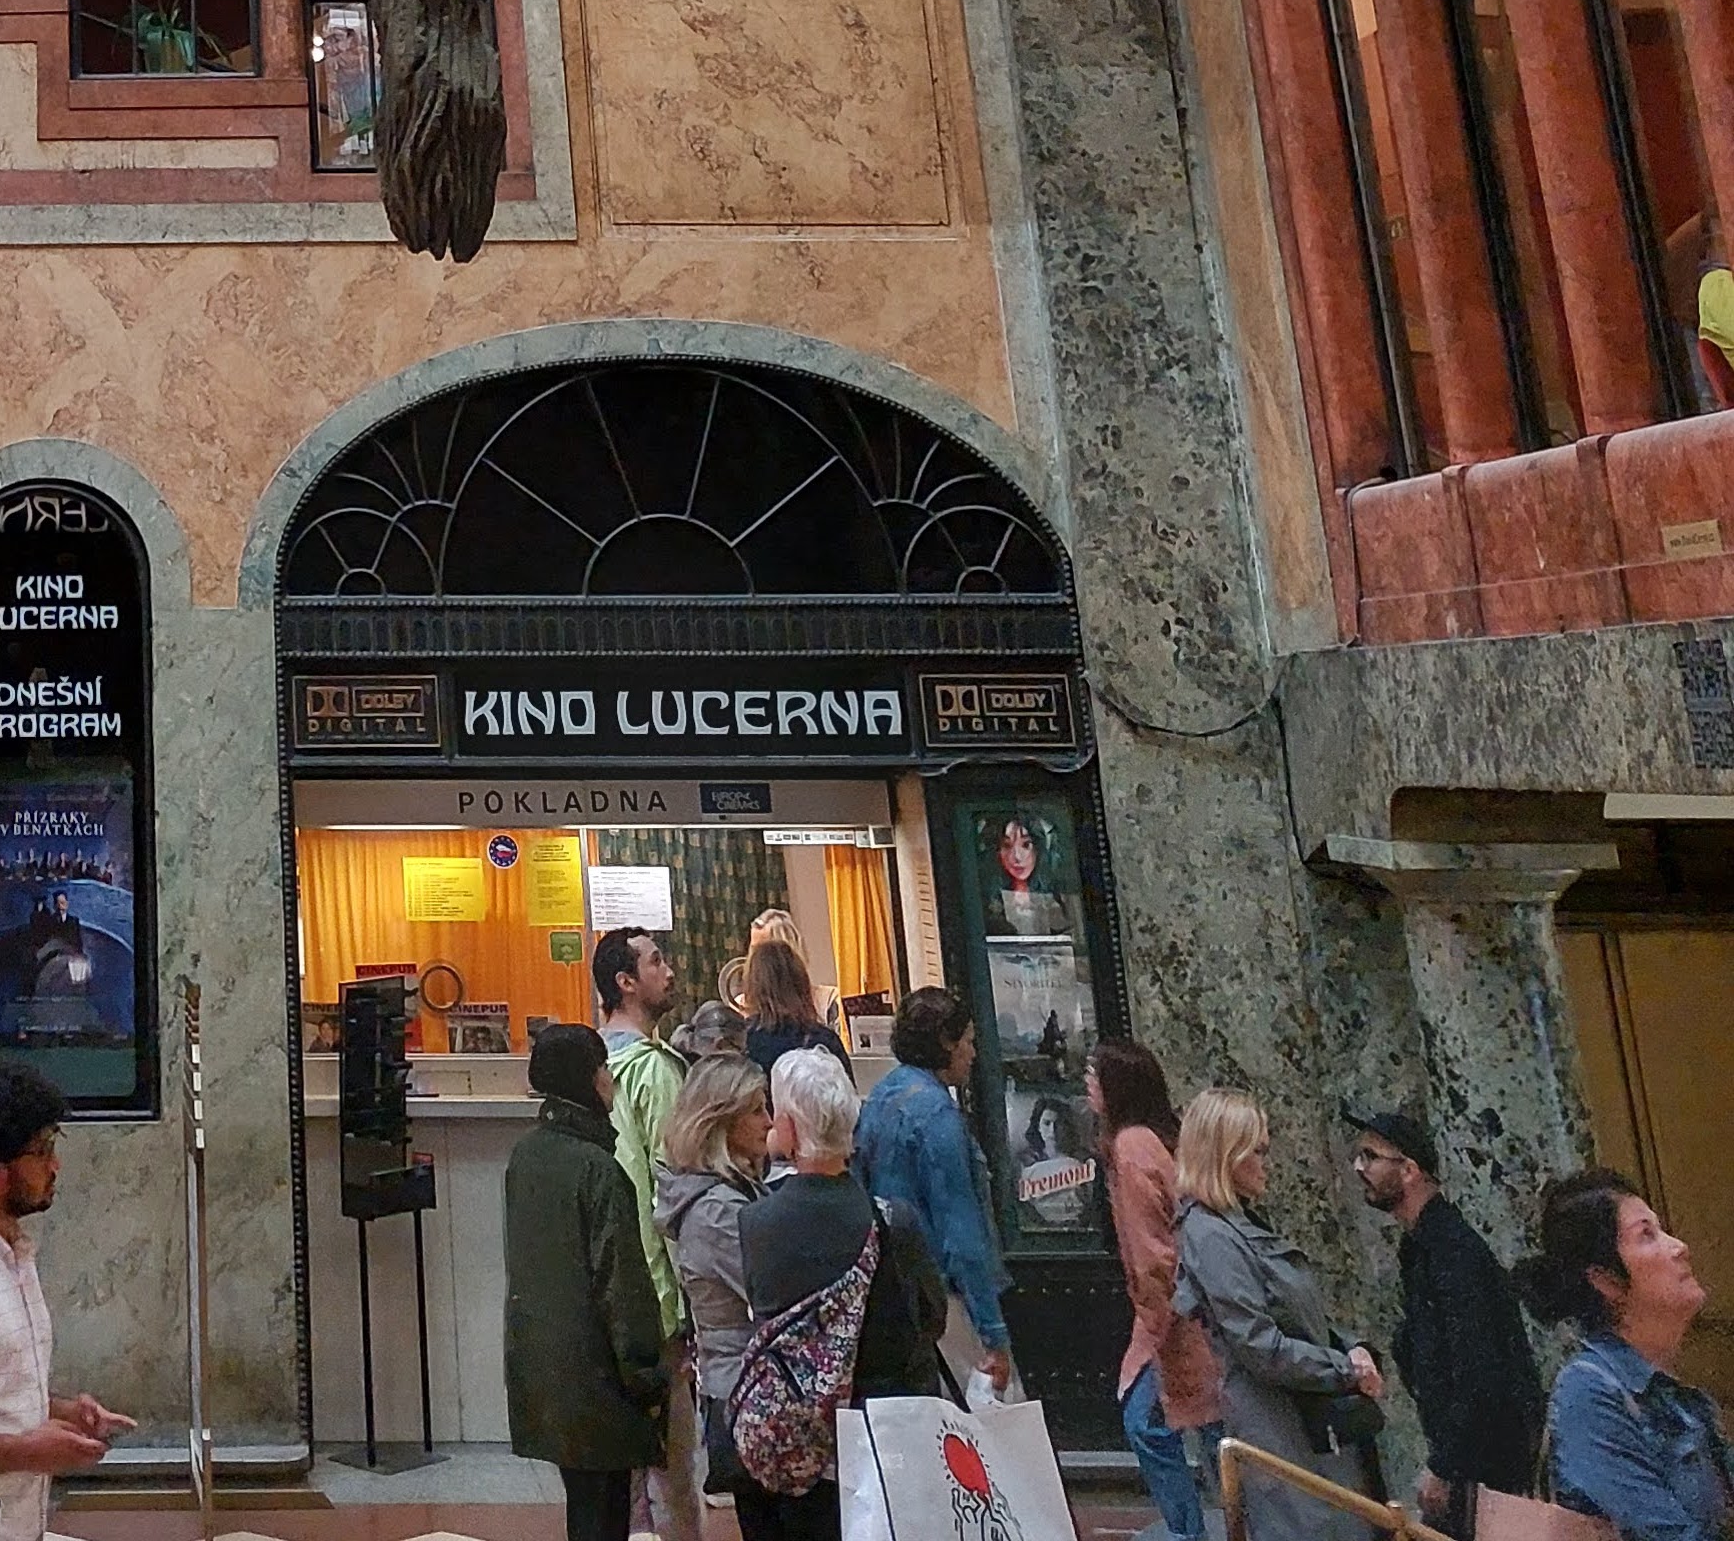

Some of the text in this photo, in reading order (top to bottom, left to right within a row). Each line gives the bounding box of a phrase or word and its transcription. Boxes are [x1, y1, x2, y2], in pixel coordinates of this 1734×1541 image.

[16, 574, 84, 600] KINO
[360, 692, 416, 710] DOLBY
[991, 692, 1045, 709] DOLBY
[465, 690, 903, 736] KINO LUCERNA
[308, 718, 426, 734] DIGITAL
[938, 717, 1059, 733] DIGITAL
[458, 789, 668, 815] POKLADNA
[14, 809, 90, 825] PŘÍZRAKY
[0, 823, 10, 837] V
